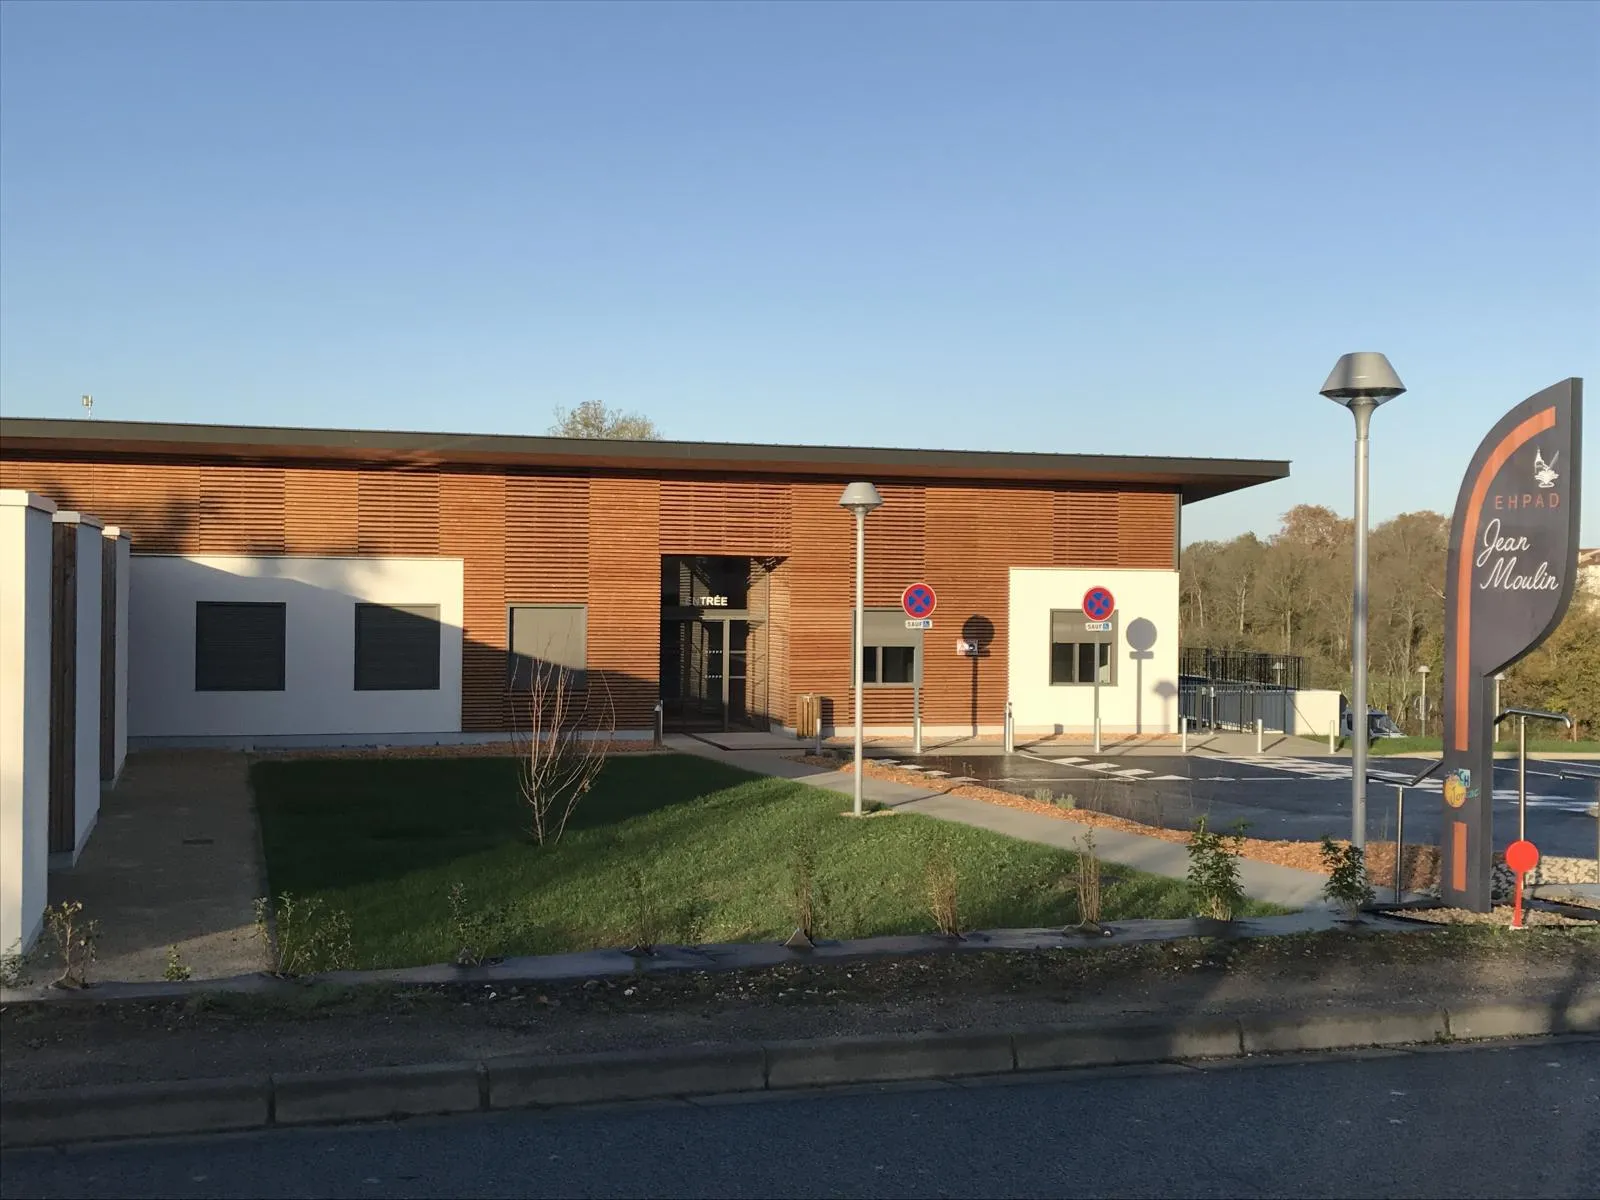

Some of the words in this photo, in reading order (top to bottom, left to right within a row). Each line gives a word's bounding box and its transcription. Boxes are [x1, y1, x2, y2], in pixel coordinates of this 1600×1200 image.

[1495, 493, 1559, 510] EHPAD
[1477, 518, 1530, 567] Jean
[1480, 557, 1559, 591] Moulin
